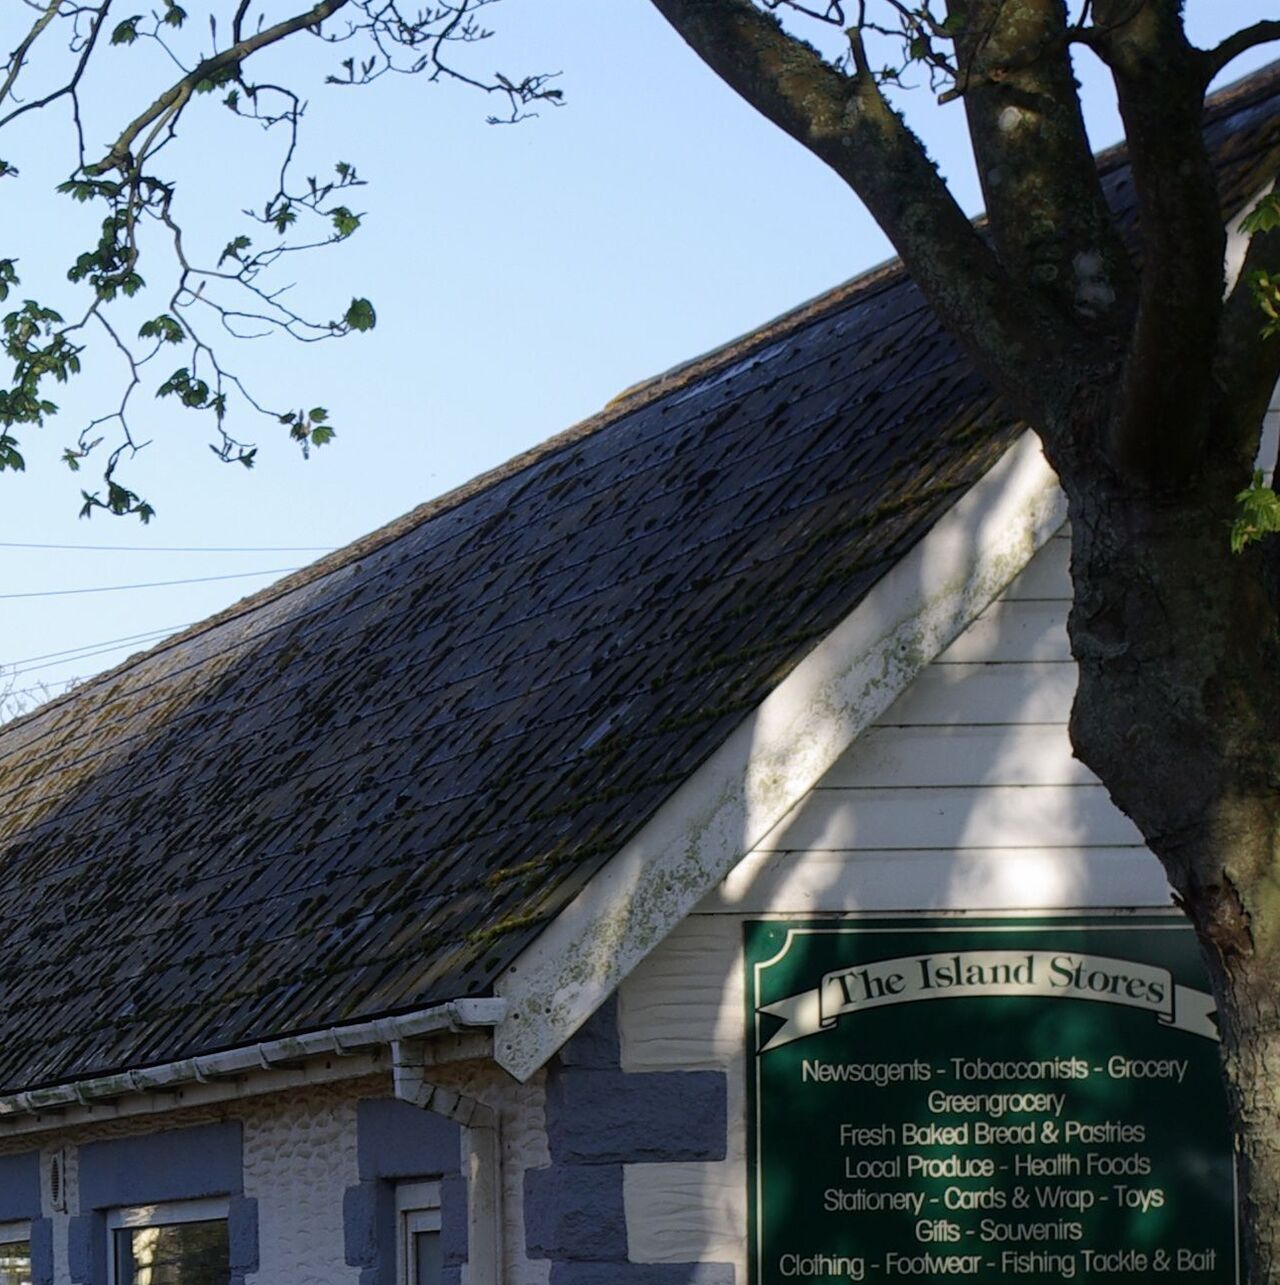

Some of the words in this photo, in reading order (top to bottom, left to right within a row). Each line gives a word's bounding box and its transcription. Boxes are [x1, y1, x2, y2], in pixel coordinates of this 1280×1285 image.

[828, 968, 906, 1006] The
[916, 954, 1036, 990] Island
[1048, 955, 1165, 1003] Stores
[801, 1058, 931, 1086] Newsagents
[950, 1056, 1088, 1080] Tobacconists
[1107, 1055, 1188, 1083] Grocery
[927, 1089, 1066, 1117] Greengrocery
[840, 1123, 896, 1146] Fresh
[902, 1121, 969, 1146] Baked
[974, 1121, 1035, 1145] Bread
[1040, 1120, 1059, 1145] &
[1064, 1120, 1146, 1144] Pastries
[845, 1155, 901, 1179] Local
[907, 1153, 995, 1179] Produce
[1014, 1153, 1081, 1177] Health
[1086, 1152, 1152, 1176] Foods
[823, 1188, 926, 1216] Stationery
[943, 1185, 1007, 1211] Cards
[1011, 1186, 1030, 1209] &
[1034, 1185, 1095, 1212] Wrap
[1113, 1184, 1166, 1213] Toys
[915, 1218, 962, 1243] Gifts
[979, 1218, 1083, 1242] Souvenirs
[779, 1253, 865, 1280] Clothing
[886, 1251, 983, 1275] Footwear
[1001, 1250, 1076, 1278] Fishing
[1080, 1249, 1148, 1272] Tackle
[1152, 1249, 1171, 1272] &
[1177, 1248, 1217, 1271] Bait
